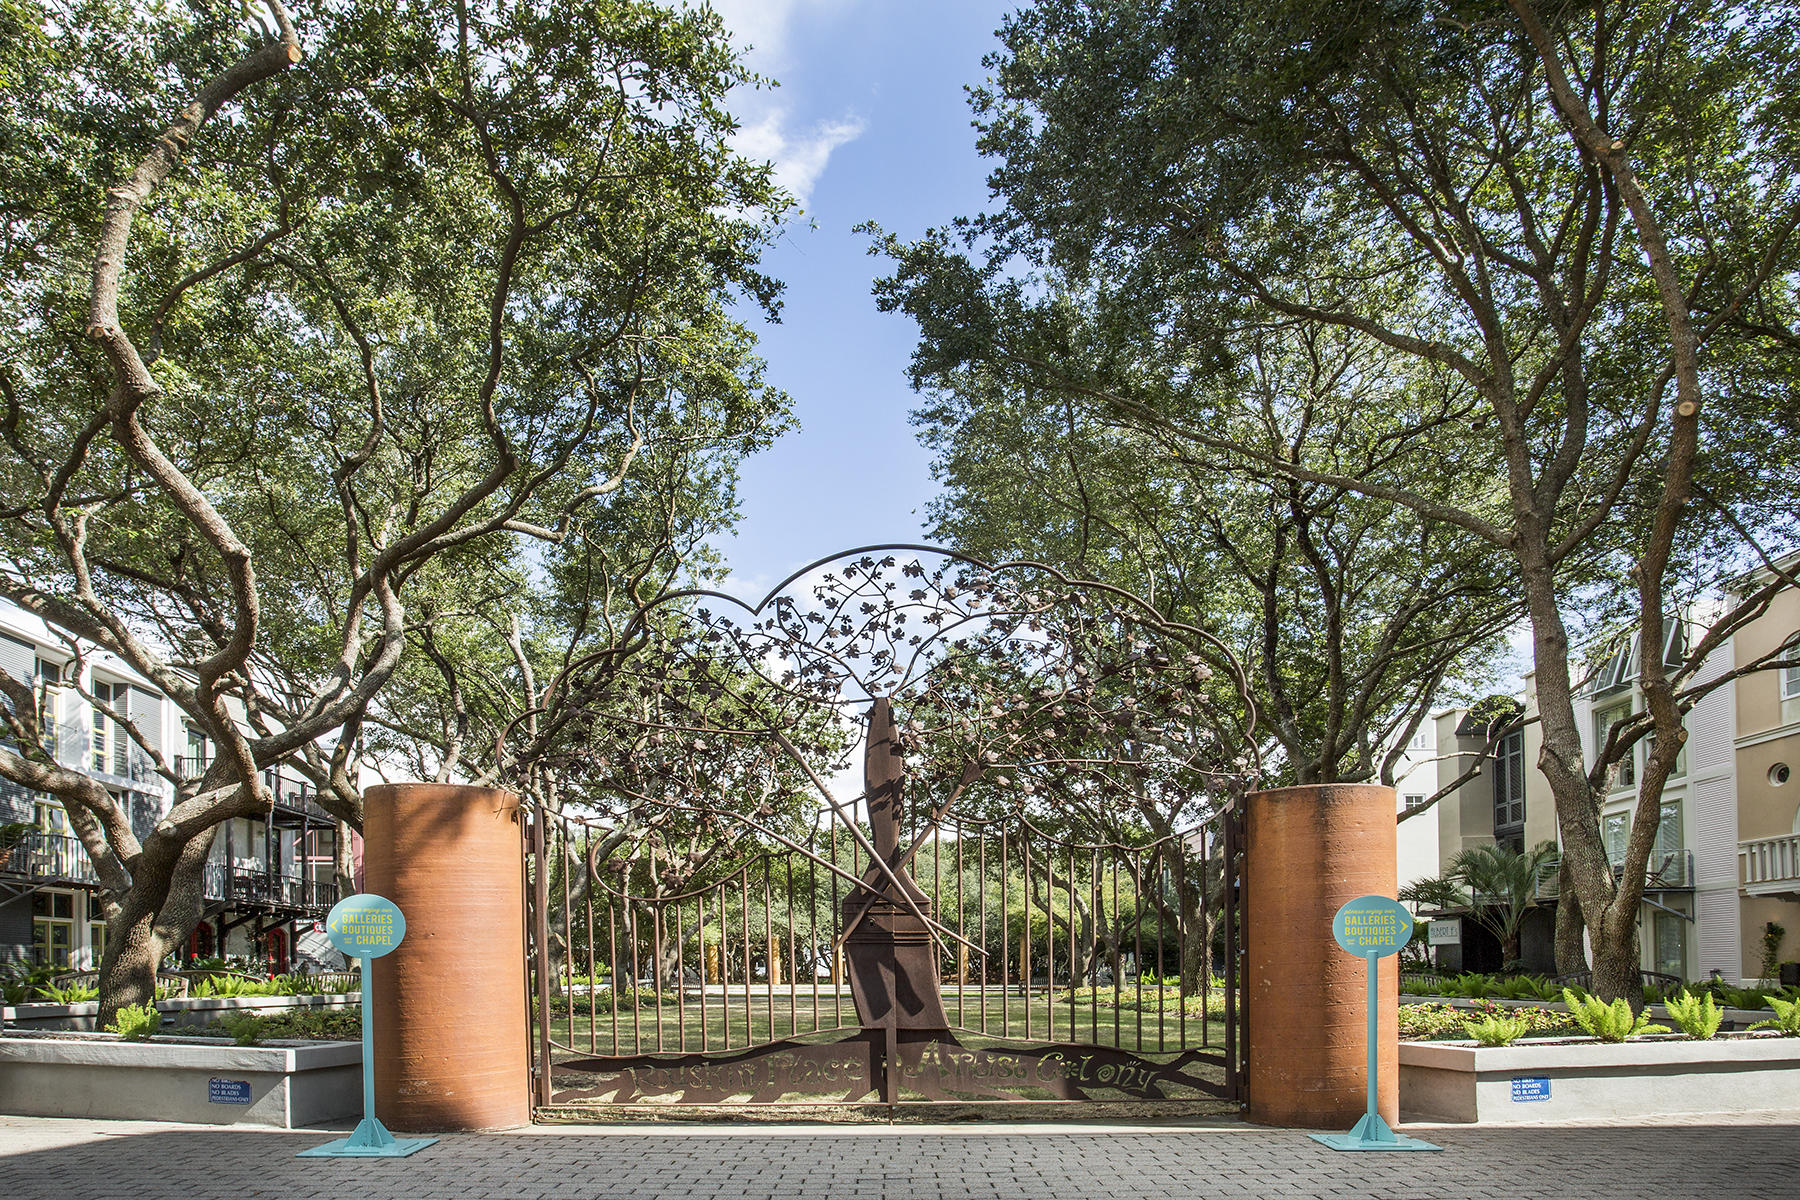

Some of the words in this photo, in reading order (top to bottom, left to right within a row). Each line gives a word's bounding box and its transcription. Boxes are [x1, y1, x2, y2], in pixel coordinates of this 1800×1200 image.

[342, 914, 393, 924] GALLERIES
[1344, 915, 1396, 925] GALLERIES
[342, 925, 393, 935] BOUTIQUES
[1344, 926, 1397, 936] BOUTIQUES
[356, 935, 393, 945] CHAPEL
[1359, 936, 1396, 946] CHAPEL
[762, 1052, 866, 1088] Place
[903, 1038, 1028, 1079] Artist
[1036, 1052, 1161, 1092] Colony
